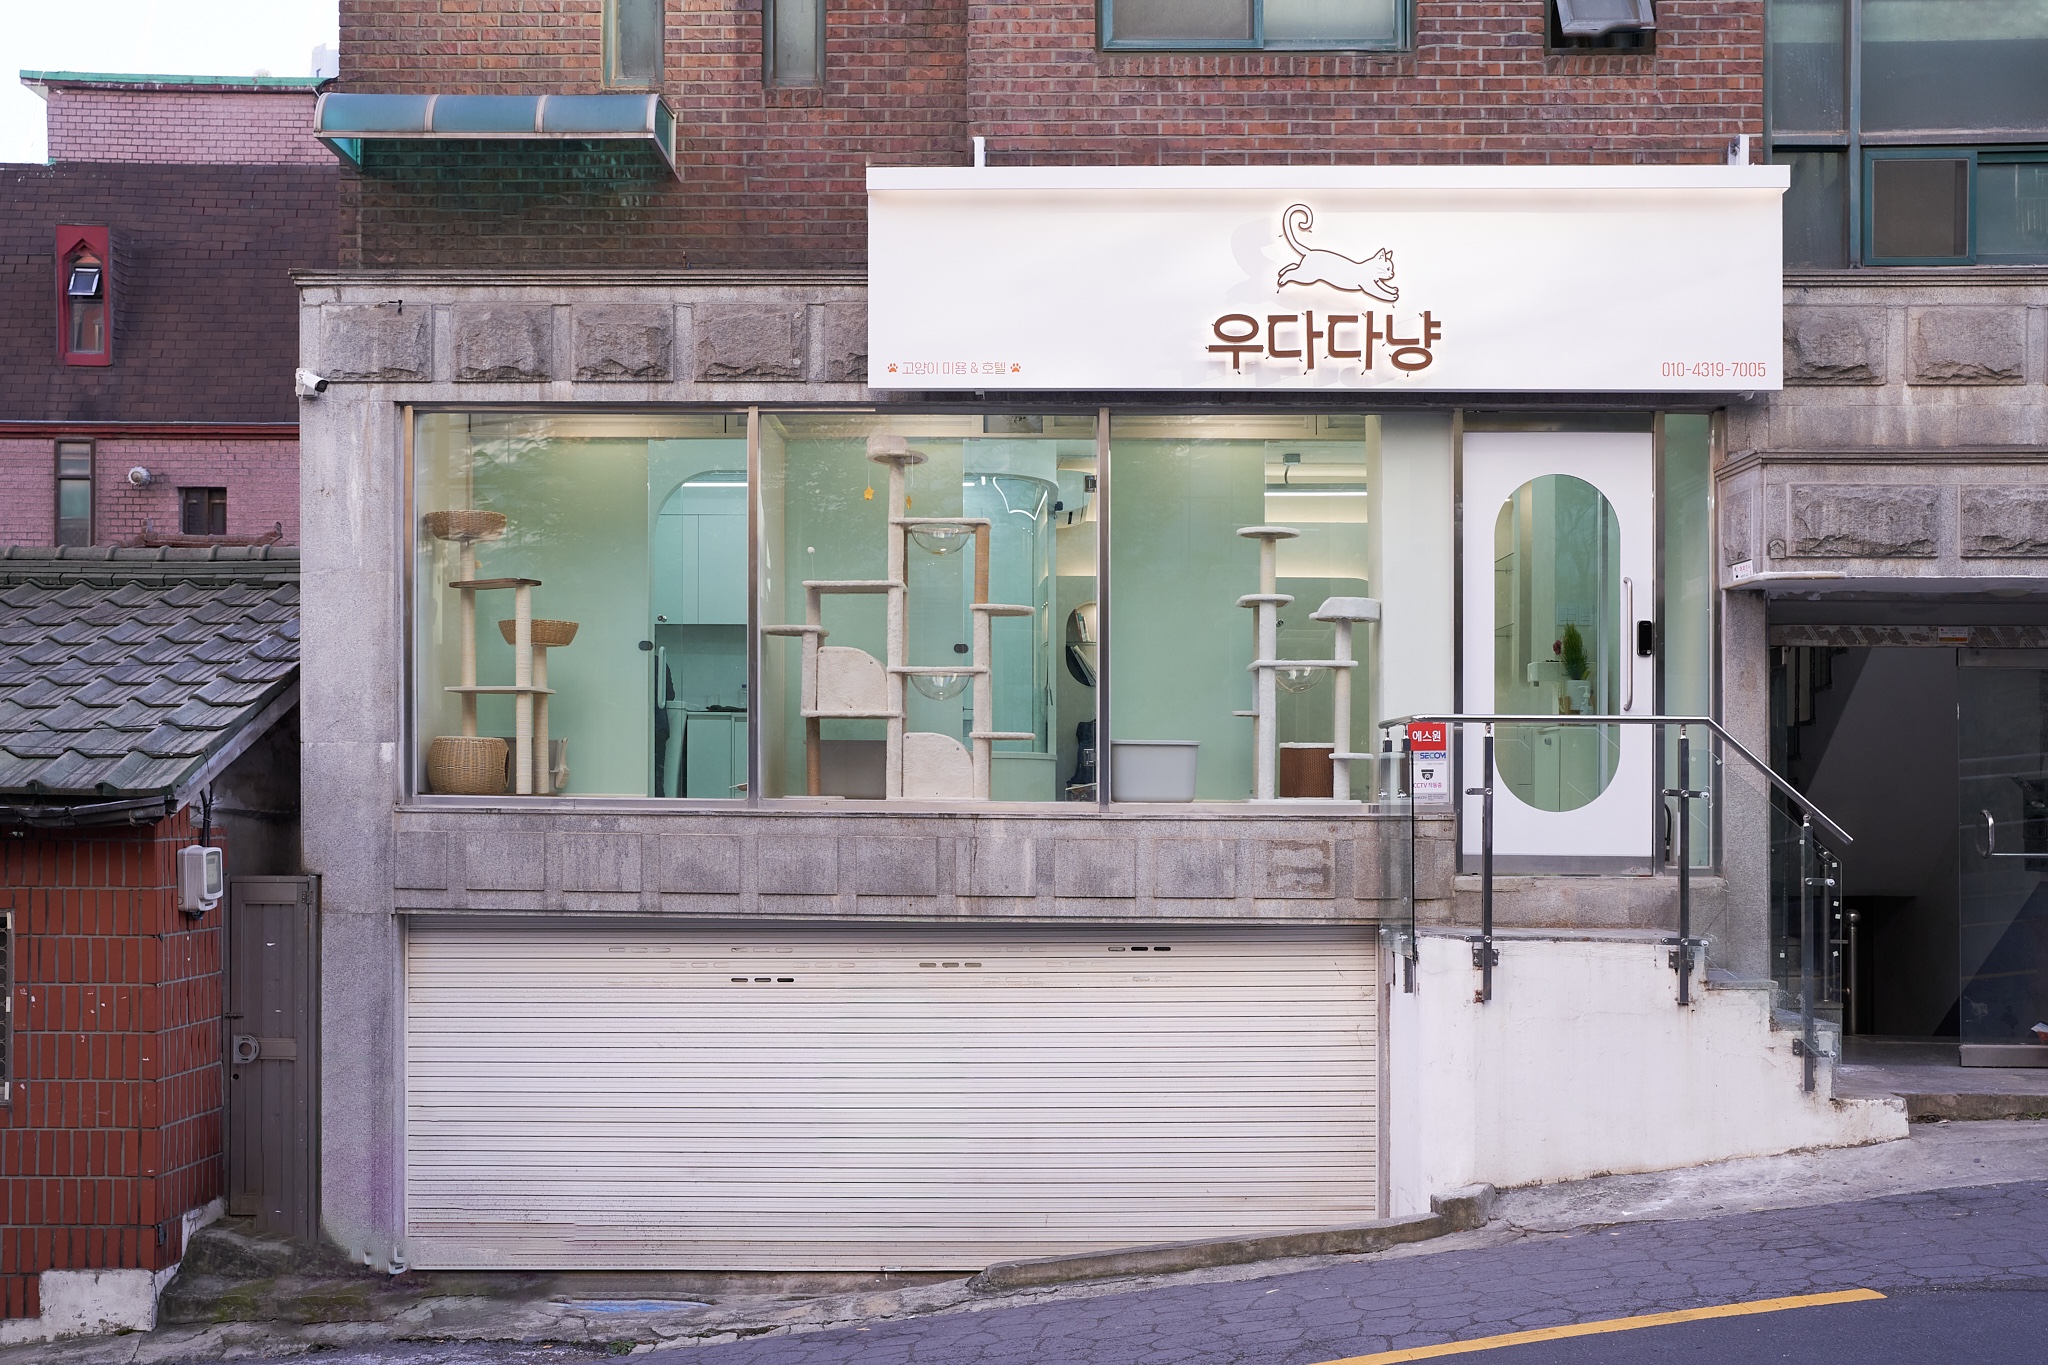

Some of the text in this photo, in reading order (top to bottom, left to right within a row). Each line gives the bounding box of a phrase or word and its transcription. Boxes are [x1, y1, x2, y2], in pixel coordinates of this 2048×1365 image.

[1208, 310, 1442, 371] 우다다냥
[902, 361, 1006, 375] 고양이 미용 & 호텔
[1662, 361, 1766, 377] 010-4319-7005
[1412, 730, 1441, 742] 에스원
